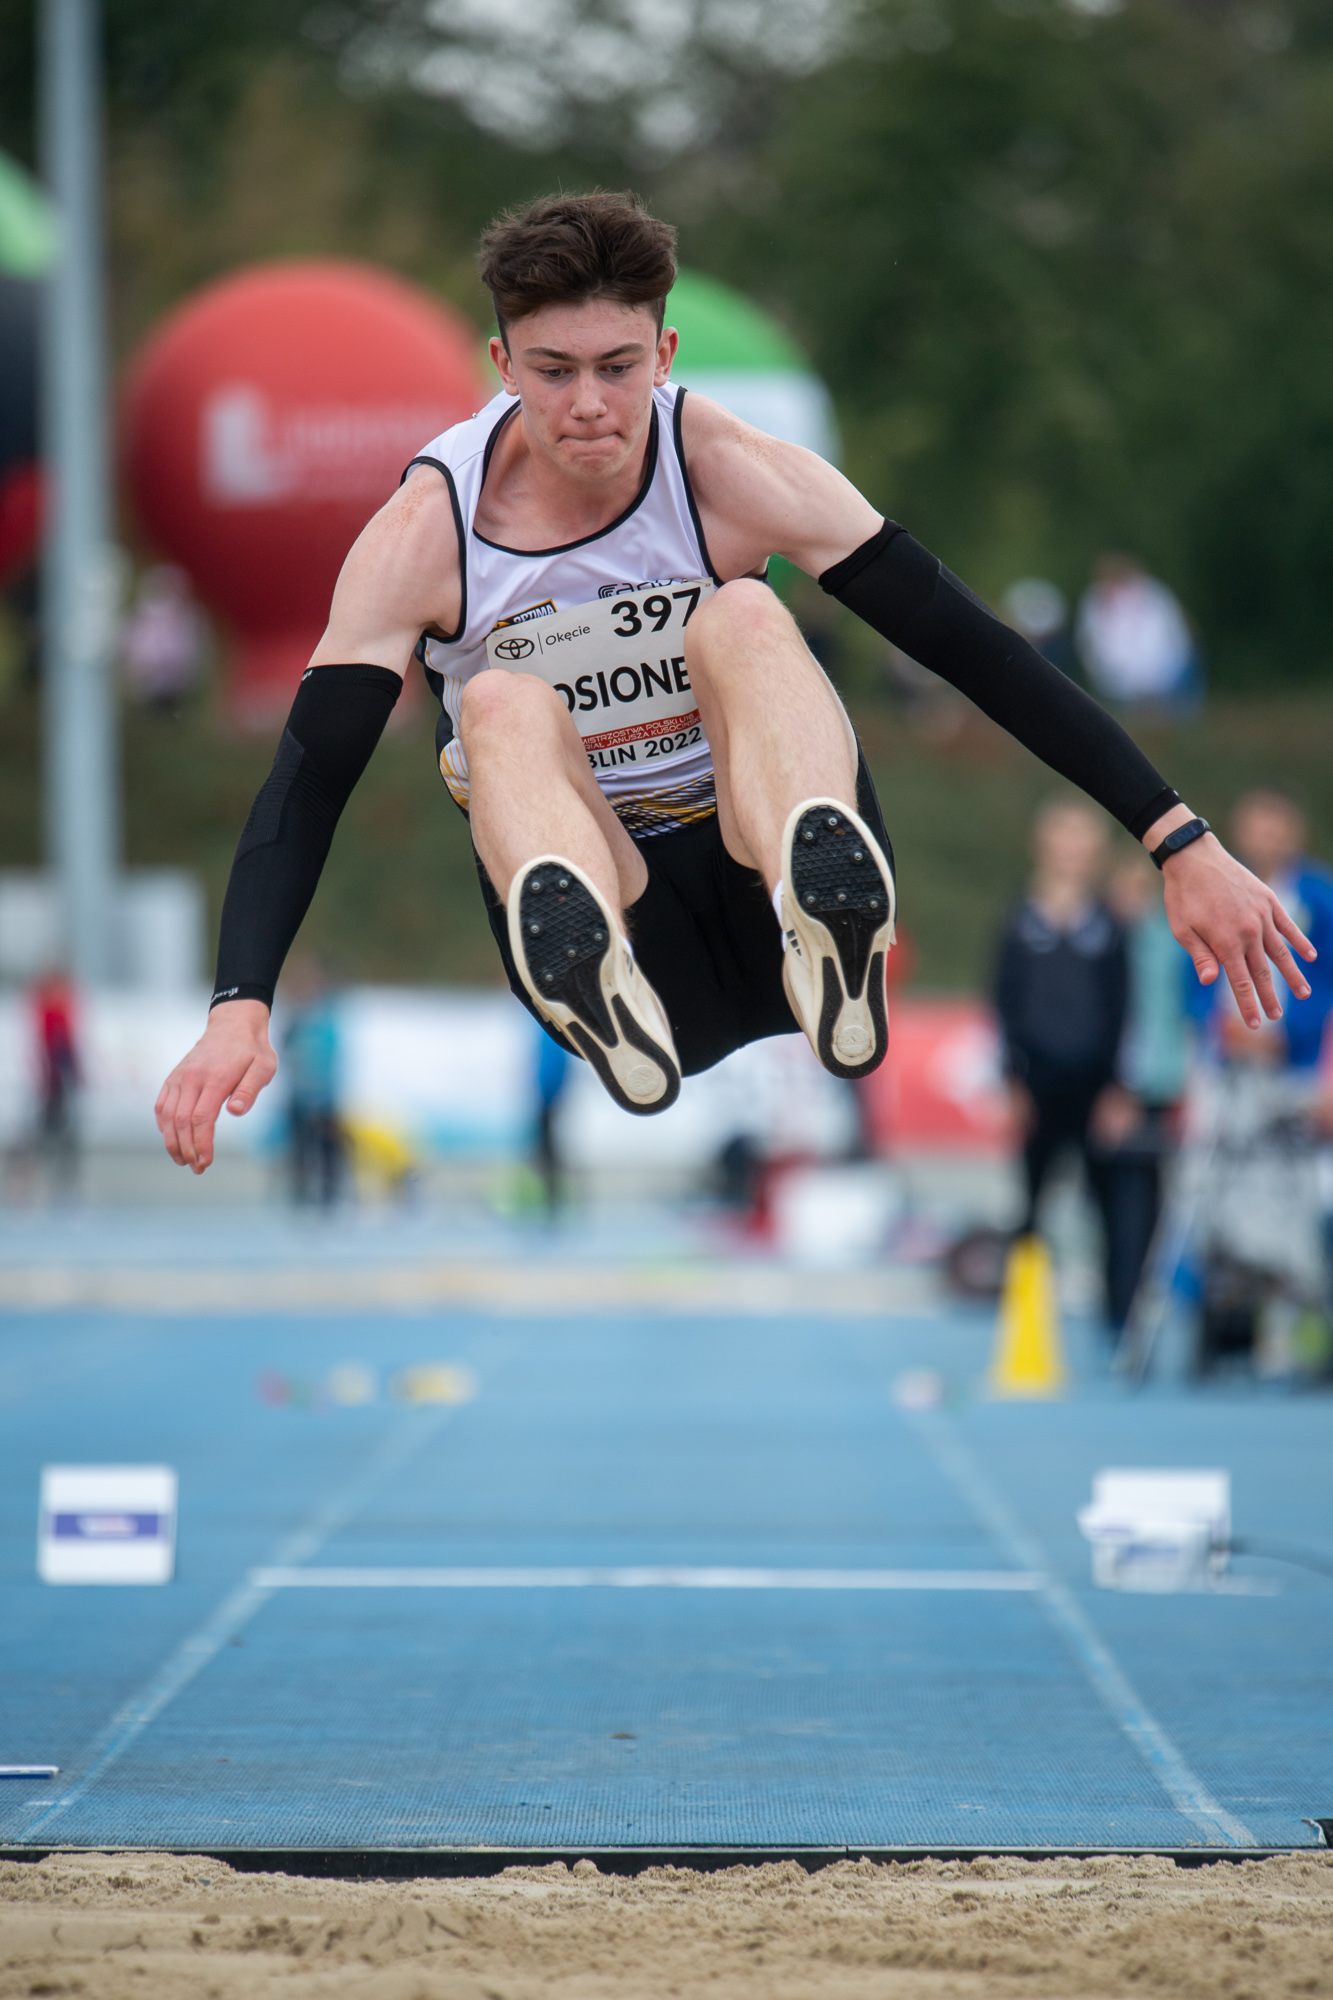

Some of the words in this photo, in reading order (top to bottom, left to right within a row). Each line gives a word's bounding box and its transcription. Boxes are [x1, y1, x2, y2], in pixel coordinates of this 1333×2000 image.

[513, 604, 555, 624] OPTIMA
[611, 586, 702, 638] 397
[545, 625, 591, 646] Okęcie
[583, 726, 645, 745] MISTRZOSTWA
[645, 718, 678, 731] POLSKI
[607, 731, 650, 747] JANUSZA
[644, 726, 702, 759] 2022
